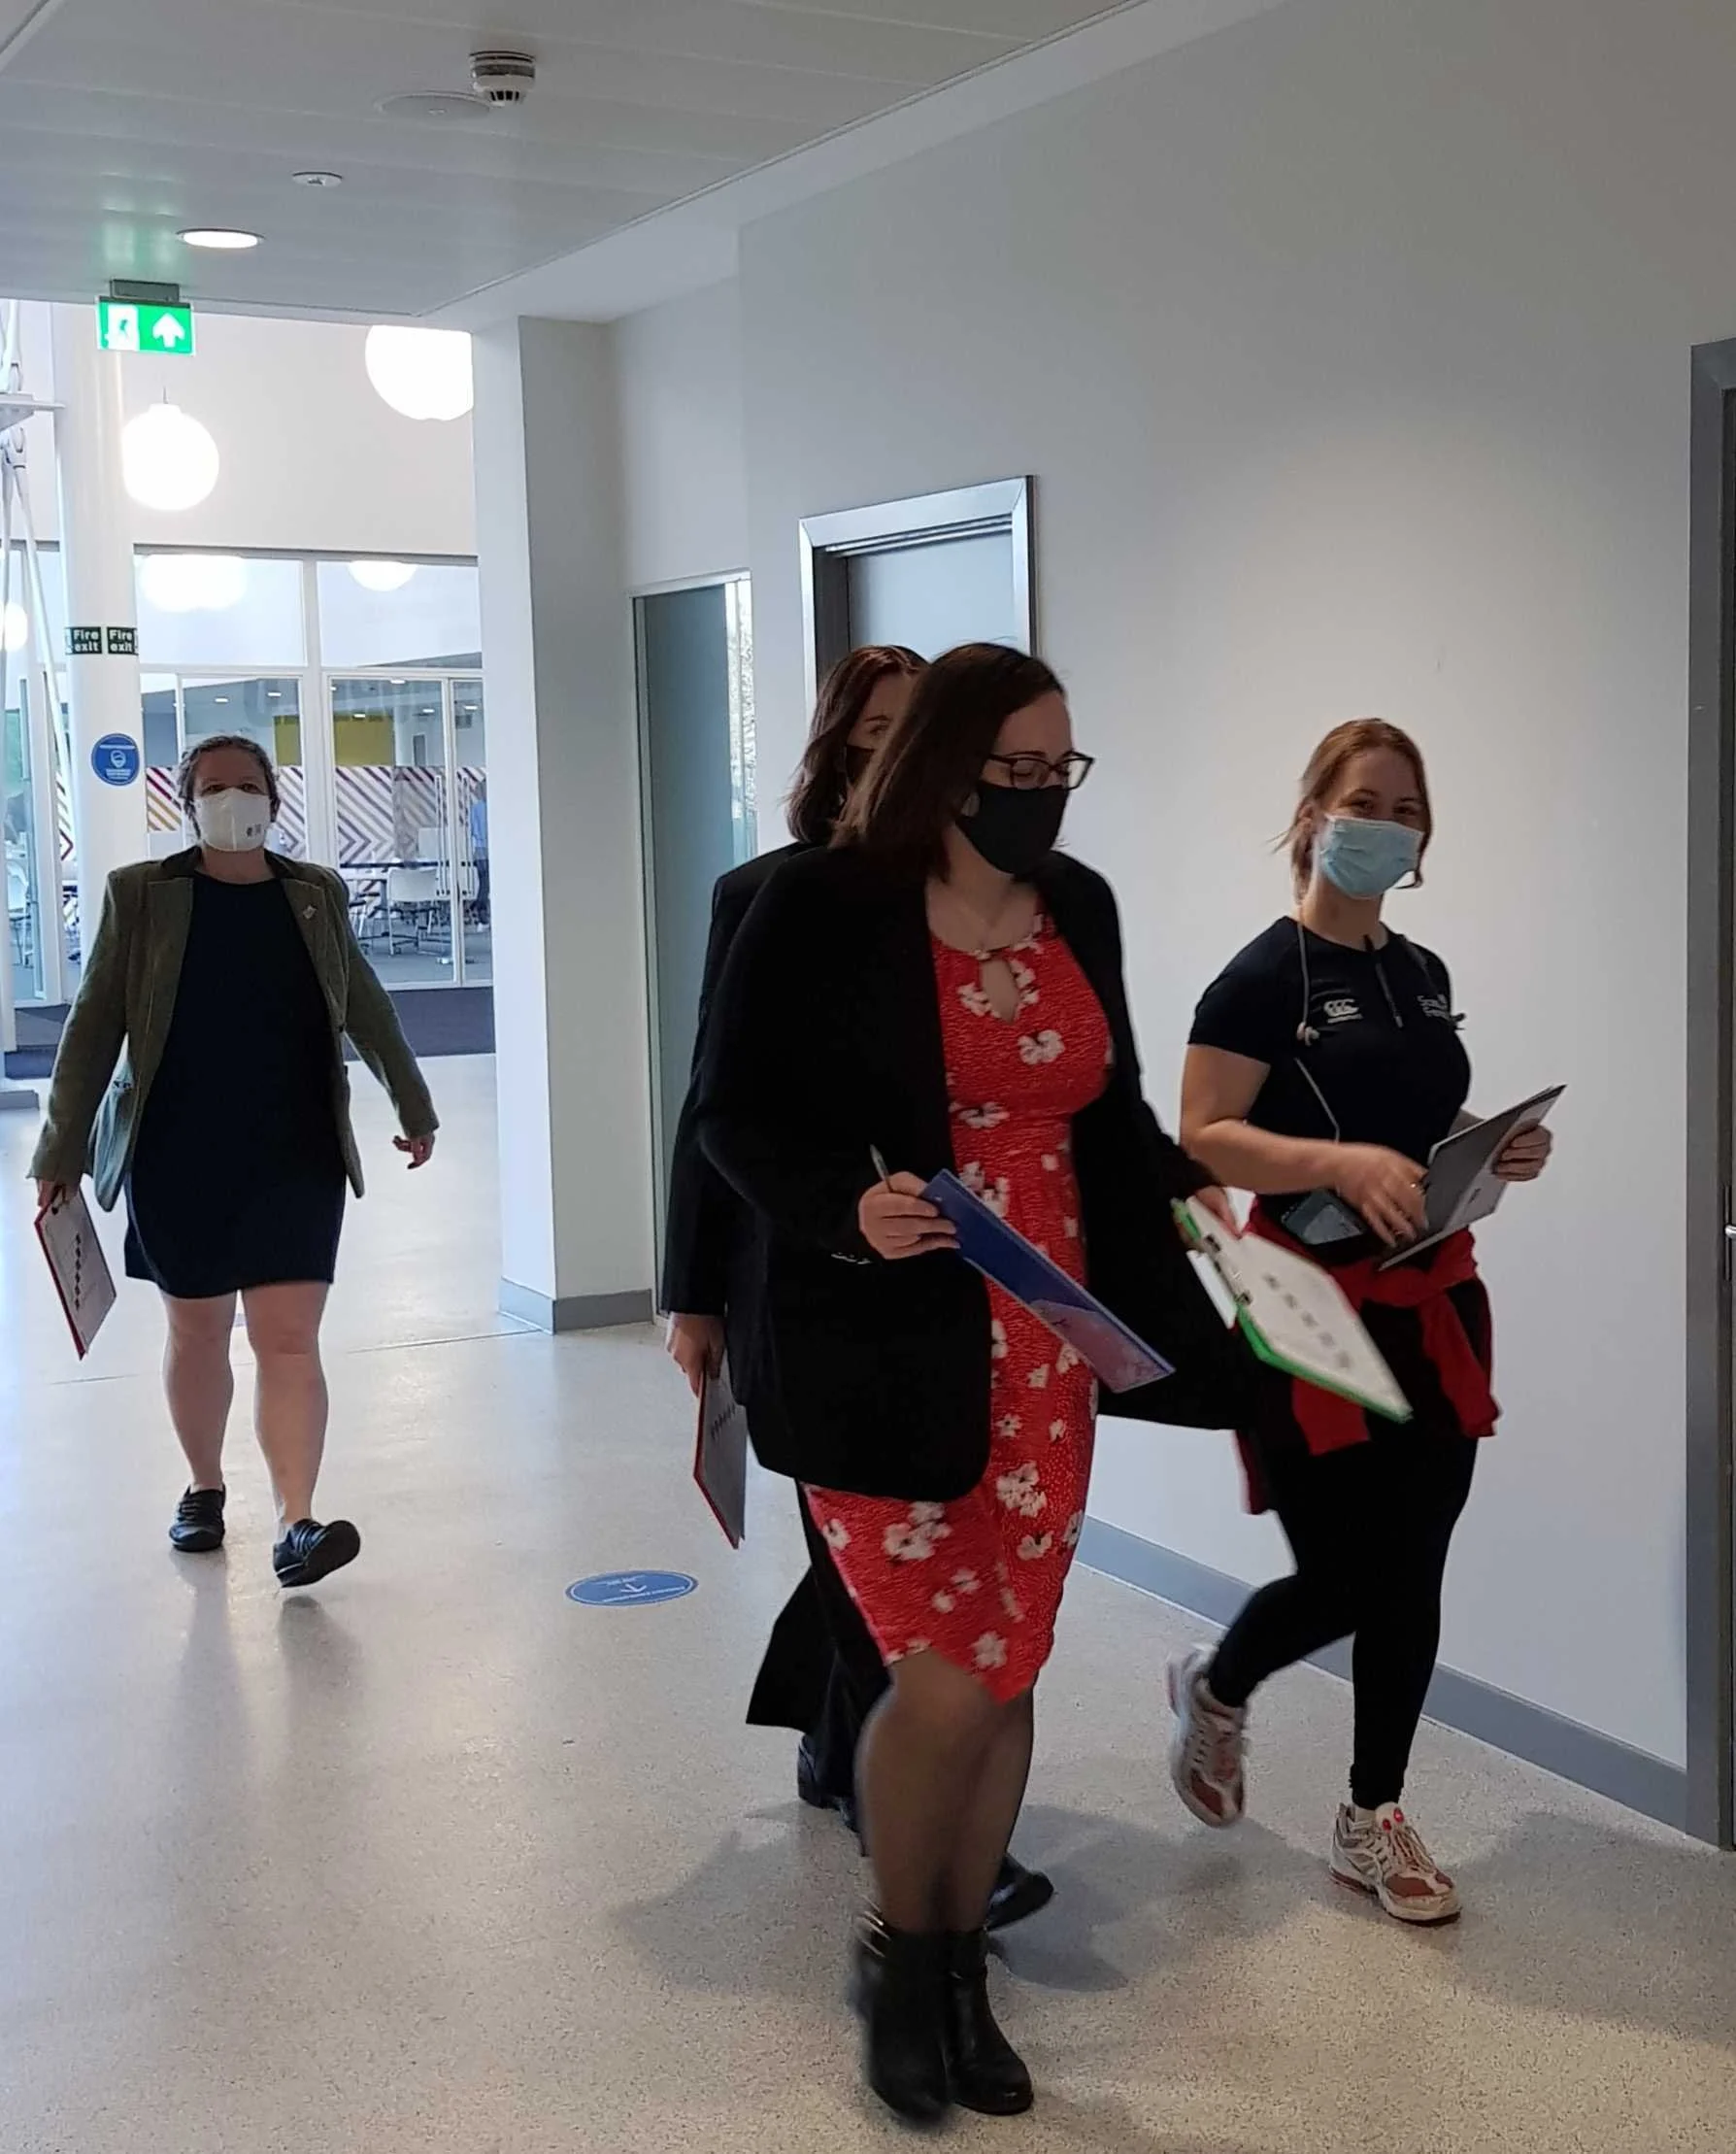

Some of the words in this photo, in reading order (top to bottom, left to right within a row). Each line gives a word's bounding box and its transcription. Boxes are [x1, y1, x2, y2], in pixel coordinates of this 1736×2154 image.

[73, 629, 99, 640] Fire
[109, 629, 133, 641] Fire
[74, 642, 99, 652] exit
[110, 642, 133, 652] exit
